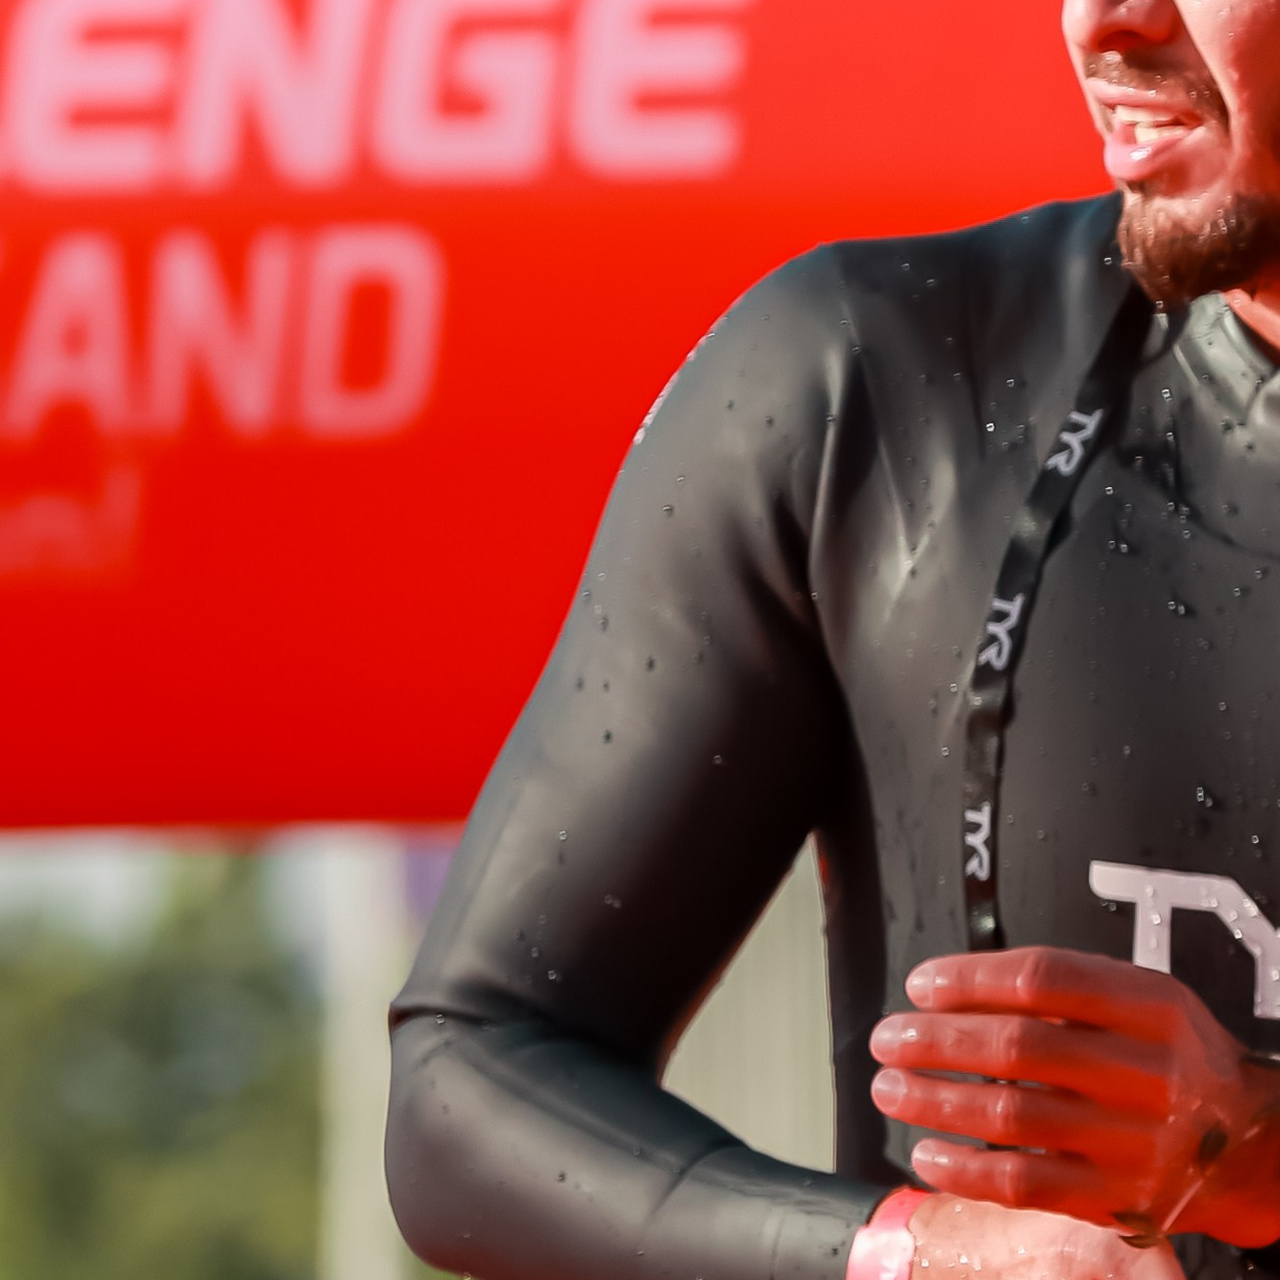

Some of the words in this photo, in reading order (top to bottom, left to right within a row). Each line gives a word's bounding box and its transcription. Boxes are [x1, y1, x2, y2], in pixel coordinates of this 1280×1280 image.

[0, 225, 446, 442] AND
[1047, 409, 1104, 476] TYR
[977, 593, 1024, 670] TYR
[964, 801, 991, 882] TYR
